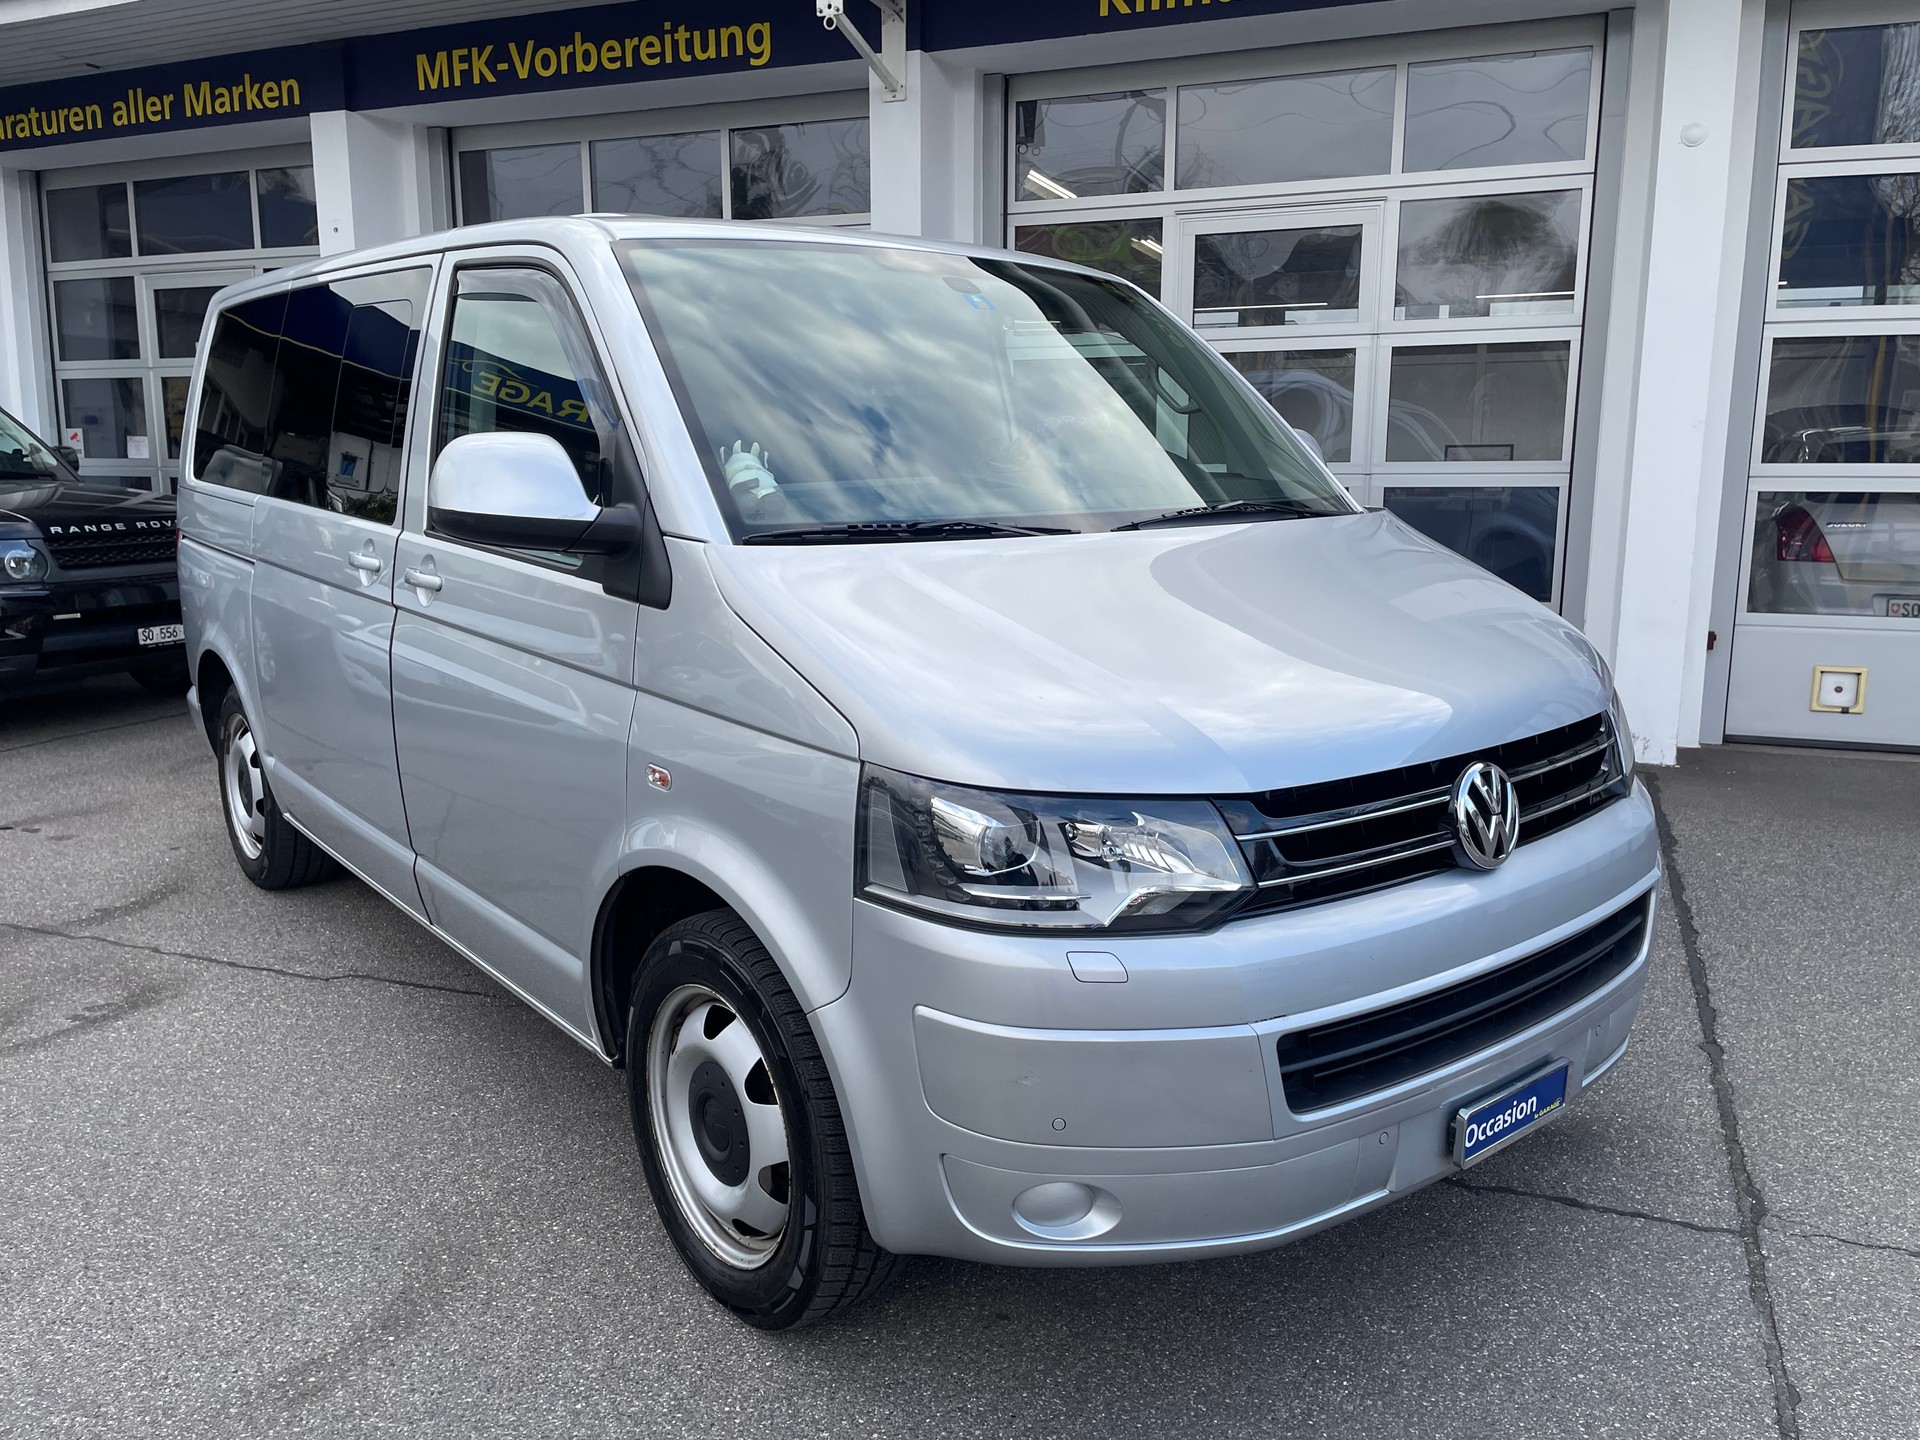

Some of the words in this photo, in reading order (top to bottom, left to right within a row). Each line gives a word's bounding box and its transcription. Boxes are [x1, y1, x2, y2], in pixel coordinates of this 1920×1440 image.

[416, 21, 771, 91] MFK-Vorbereitung
[112, 87, 174, 127] aller
[183, 73, 301, 118] Marken
[49, 523, 127, 535] RANGE
[135, 519, 178, 529] ROV
[1465, 1096, 1537, 1148] Occasion
